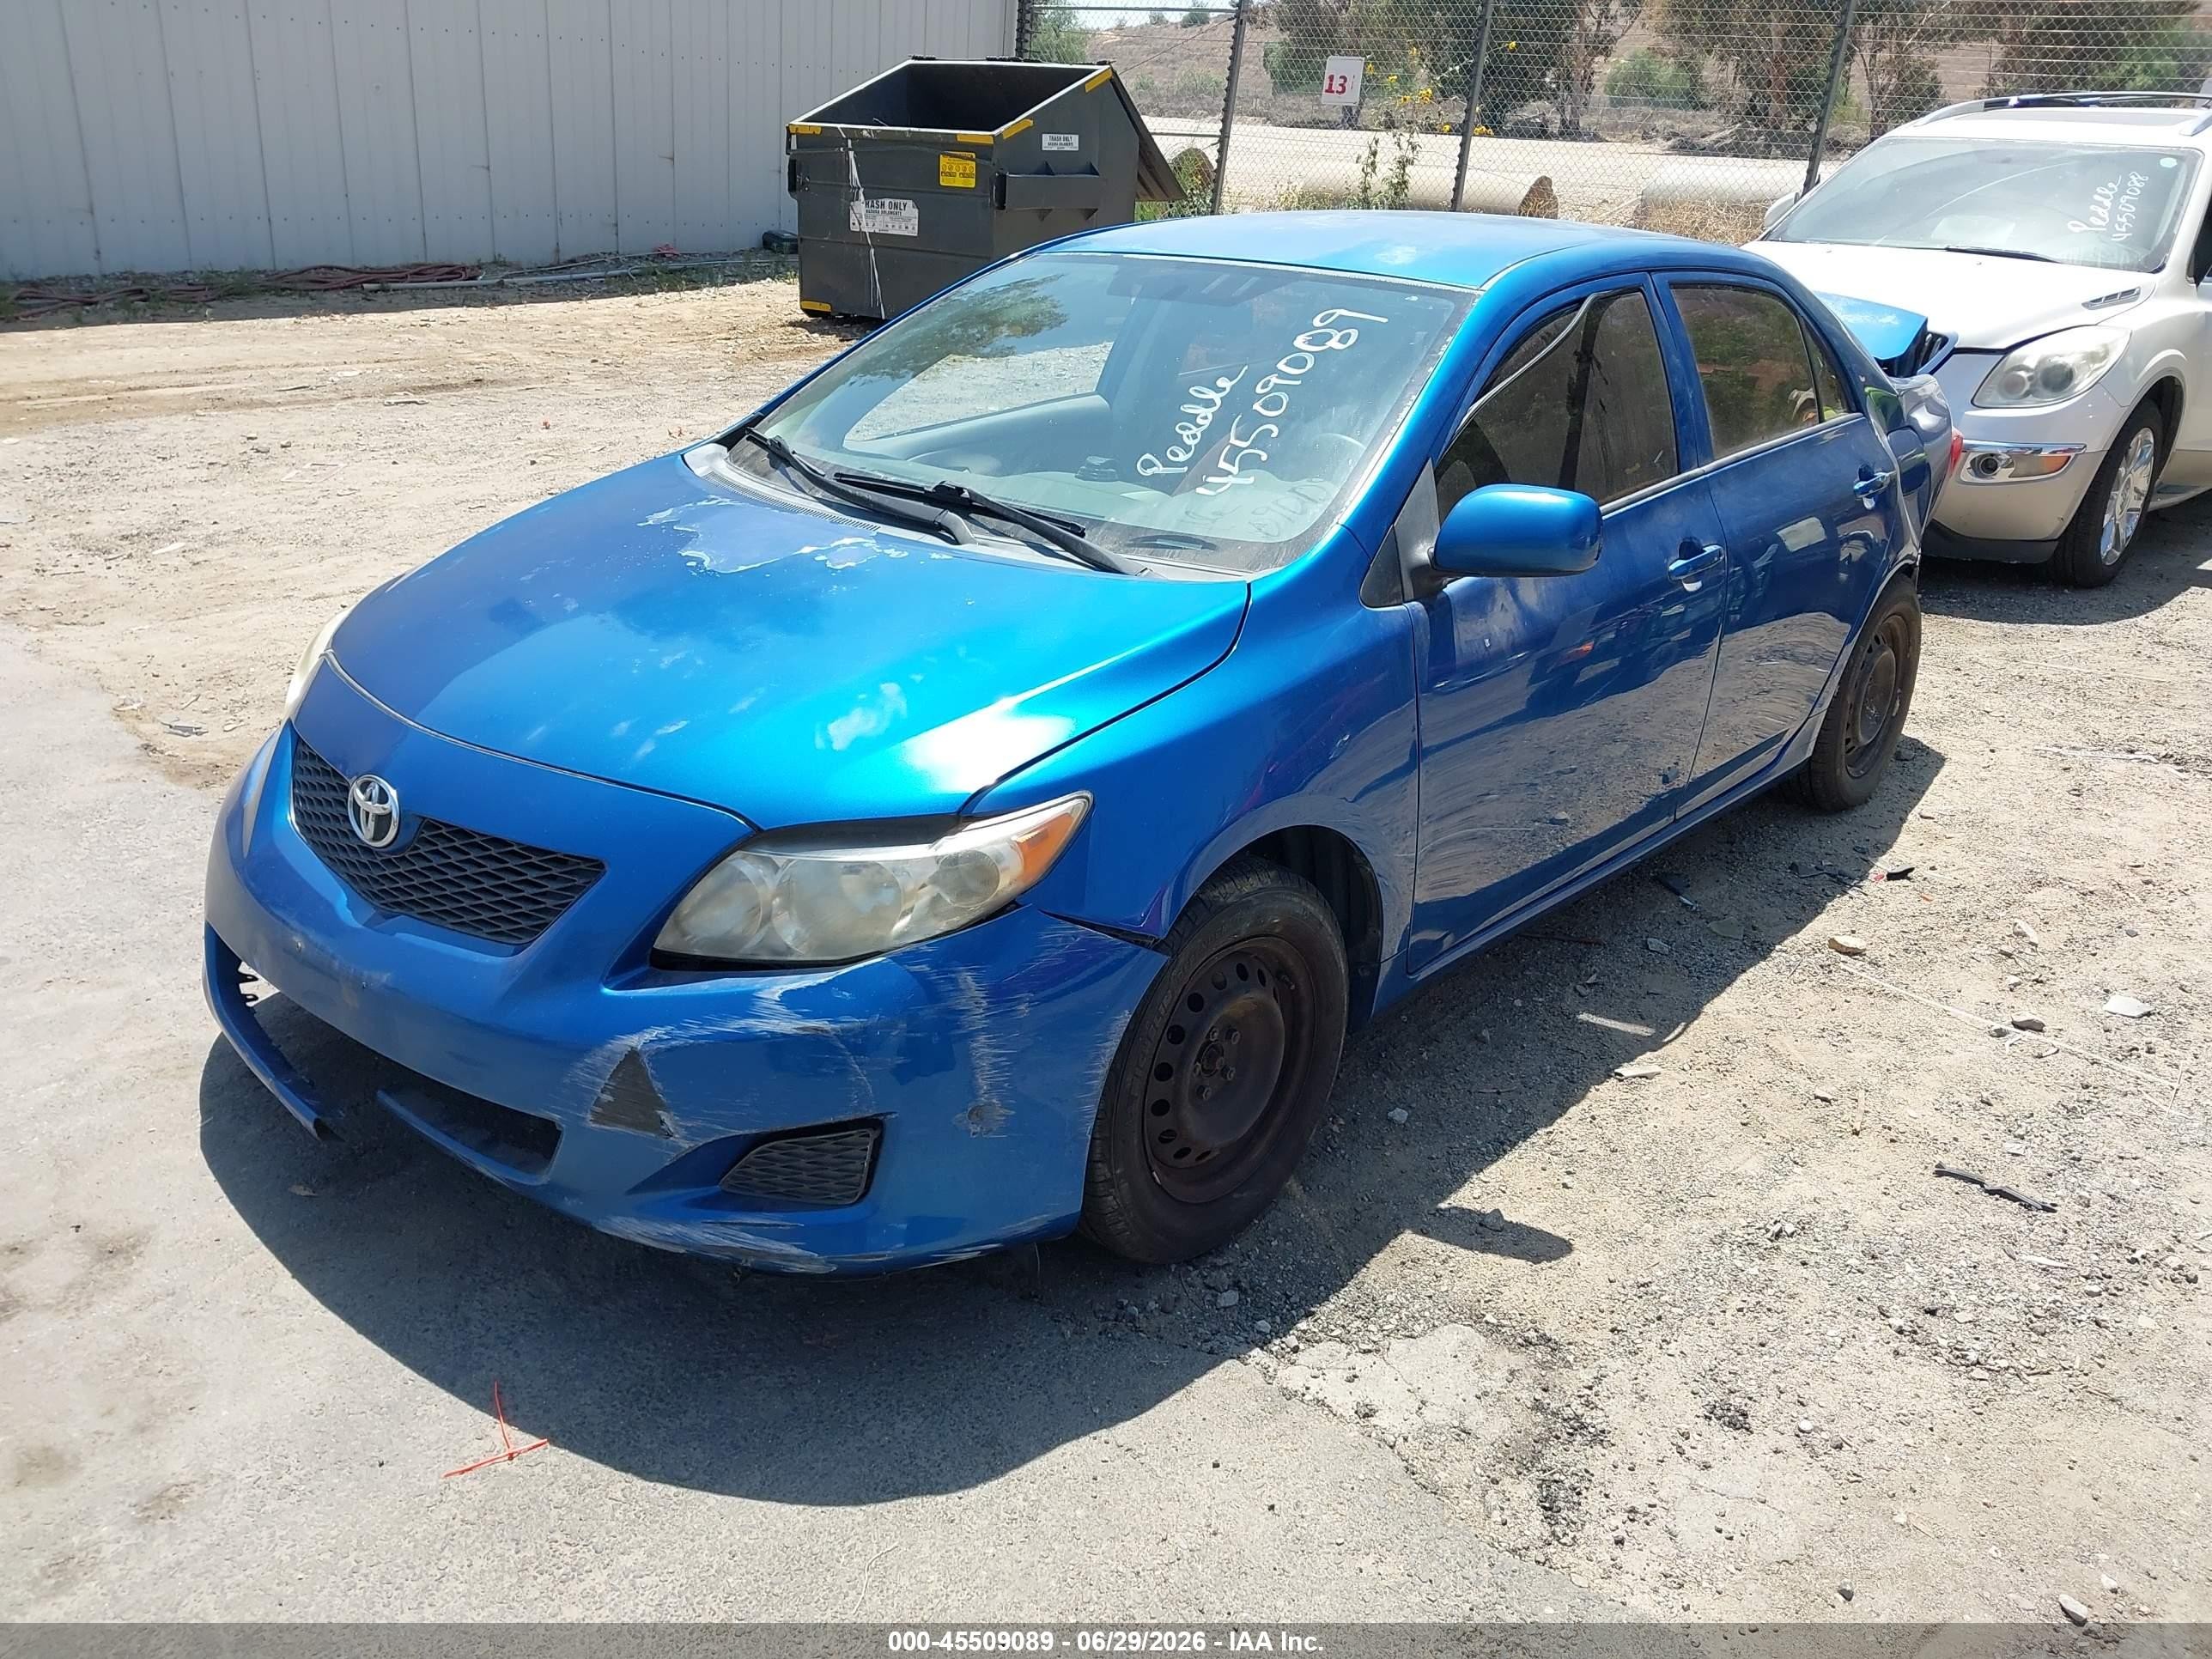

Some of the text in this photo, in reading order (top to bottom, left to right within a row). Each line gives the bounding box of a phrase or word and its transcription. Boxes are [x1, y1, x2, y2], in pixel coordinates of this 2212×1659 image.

[1324, 74, 1347, 94] 13
[888, 201, 908, 211] ONLY
[1195, 308, 1389, 496] 45509089
